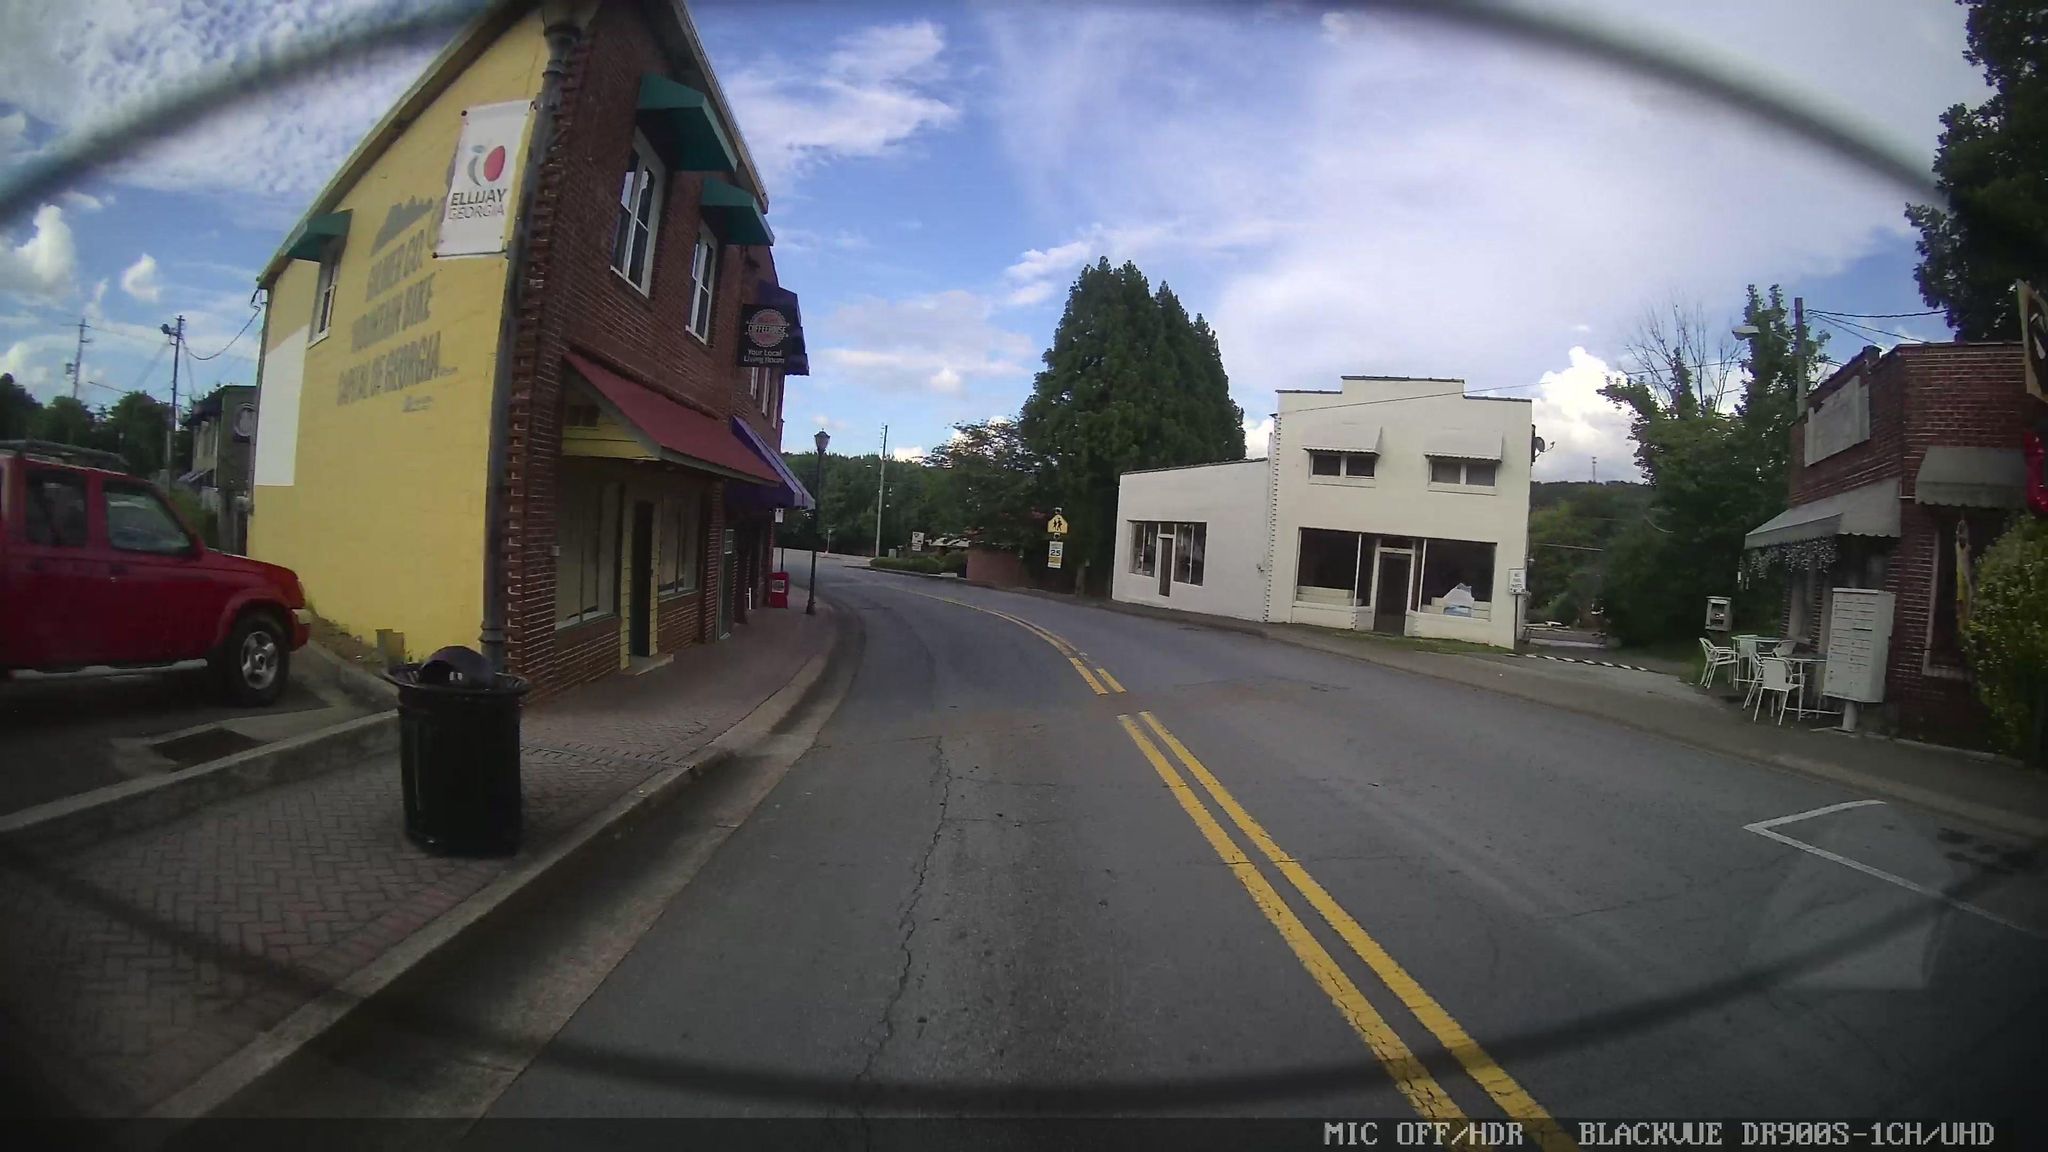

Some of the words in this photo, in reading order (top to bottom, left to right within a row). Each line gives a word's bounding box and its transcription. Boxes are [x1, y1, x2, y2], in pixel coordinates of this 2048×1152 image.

[451, 188, 507, 206] ELLIJAY
[448, 205, 505, 219] GEORGIA
[748, 324, 786, 333] CFFEESE
[764, 349, 782, 357] Local
